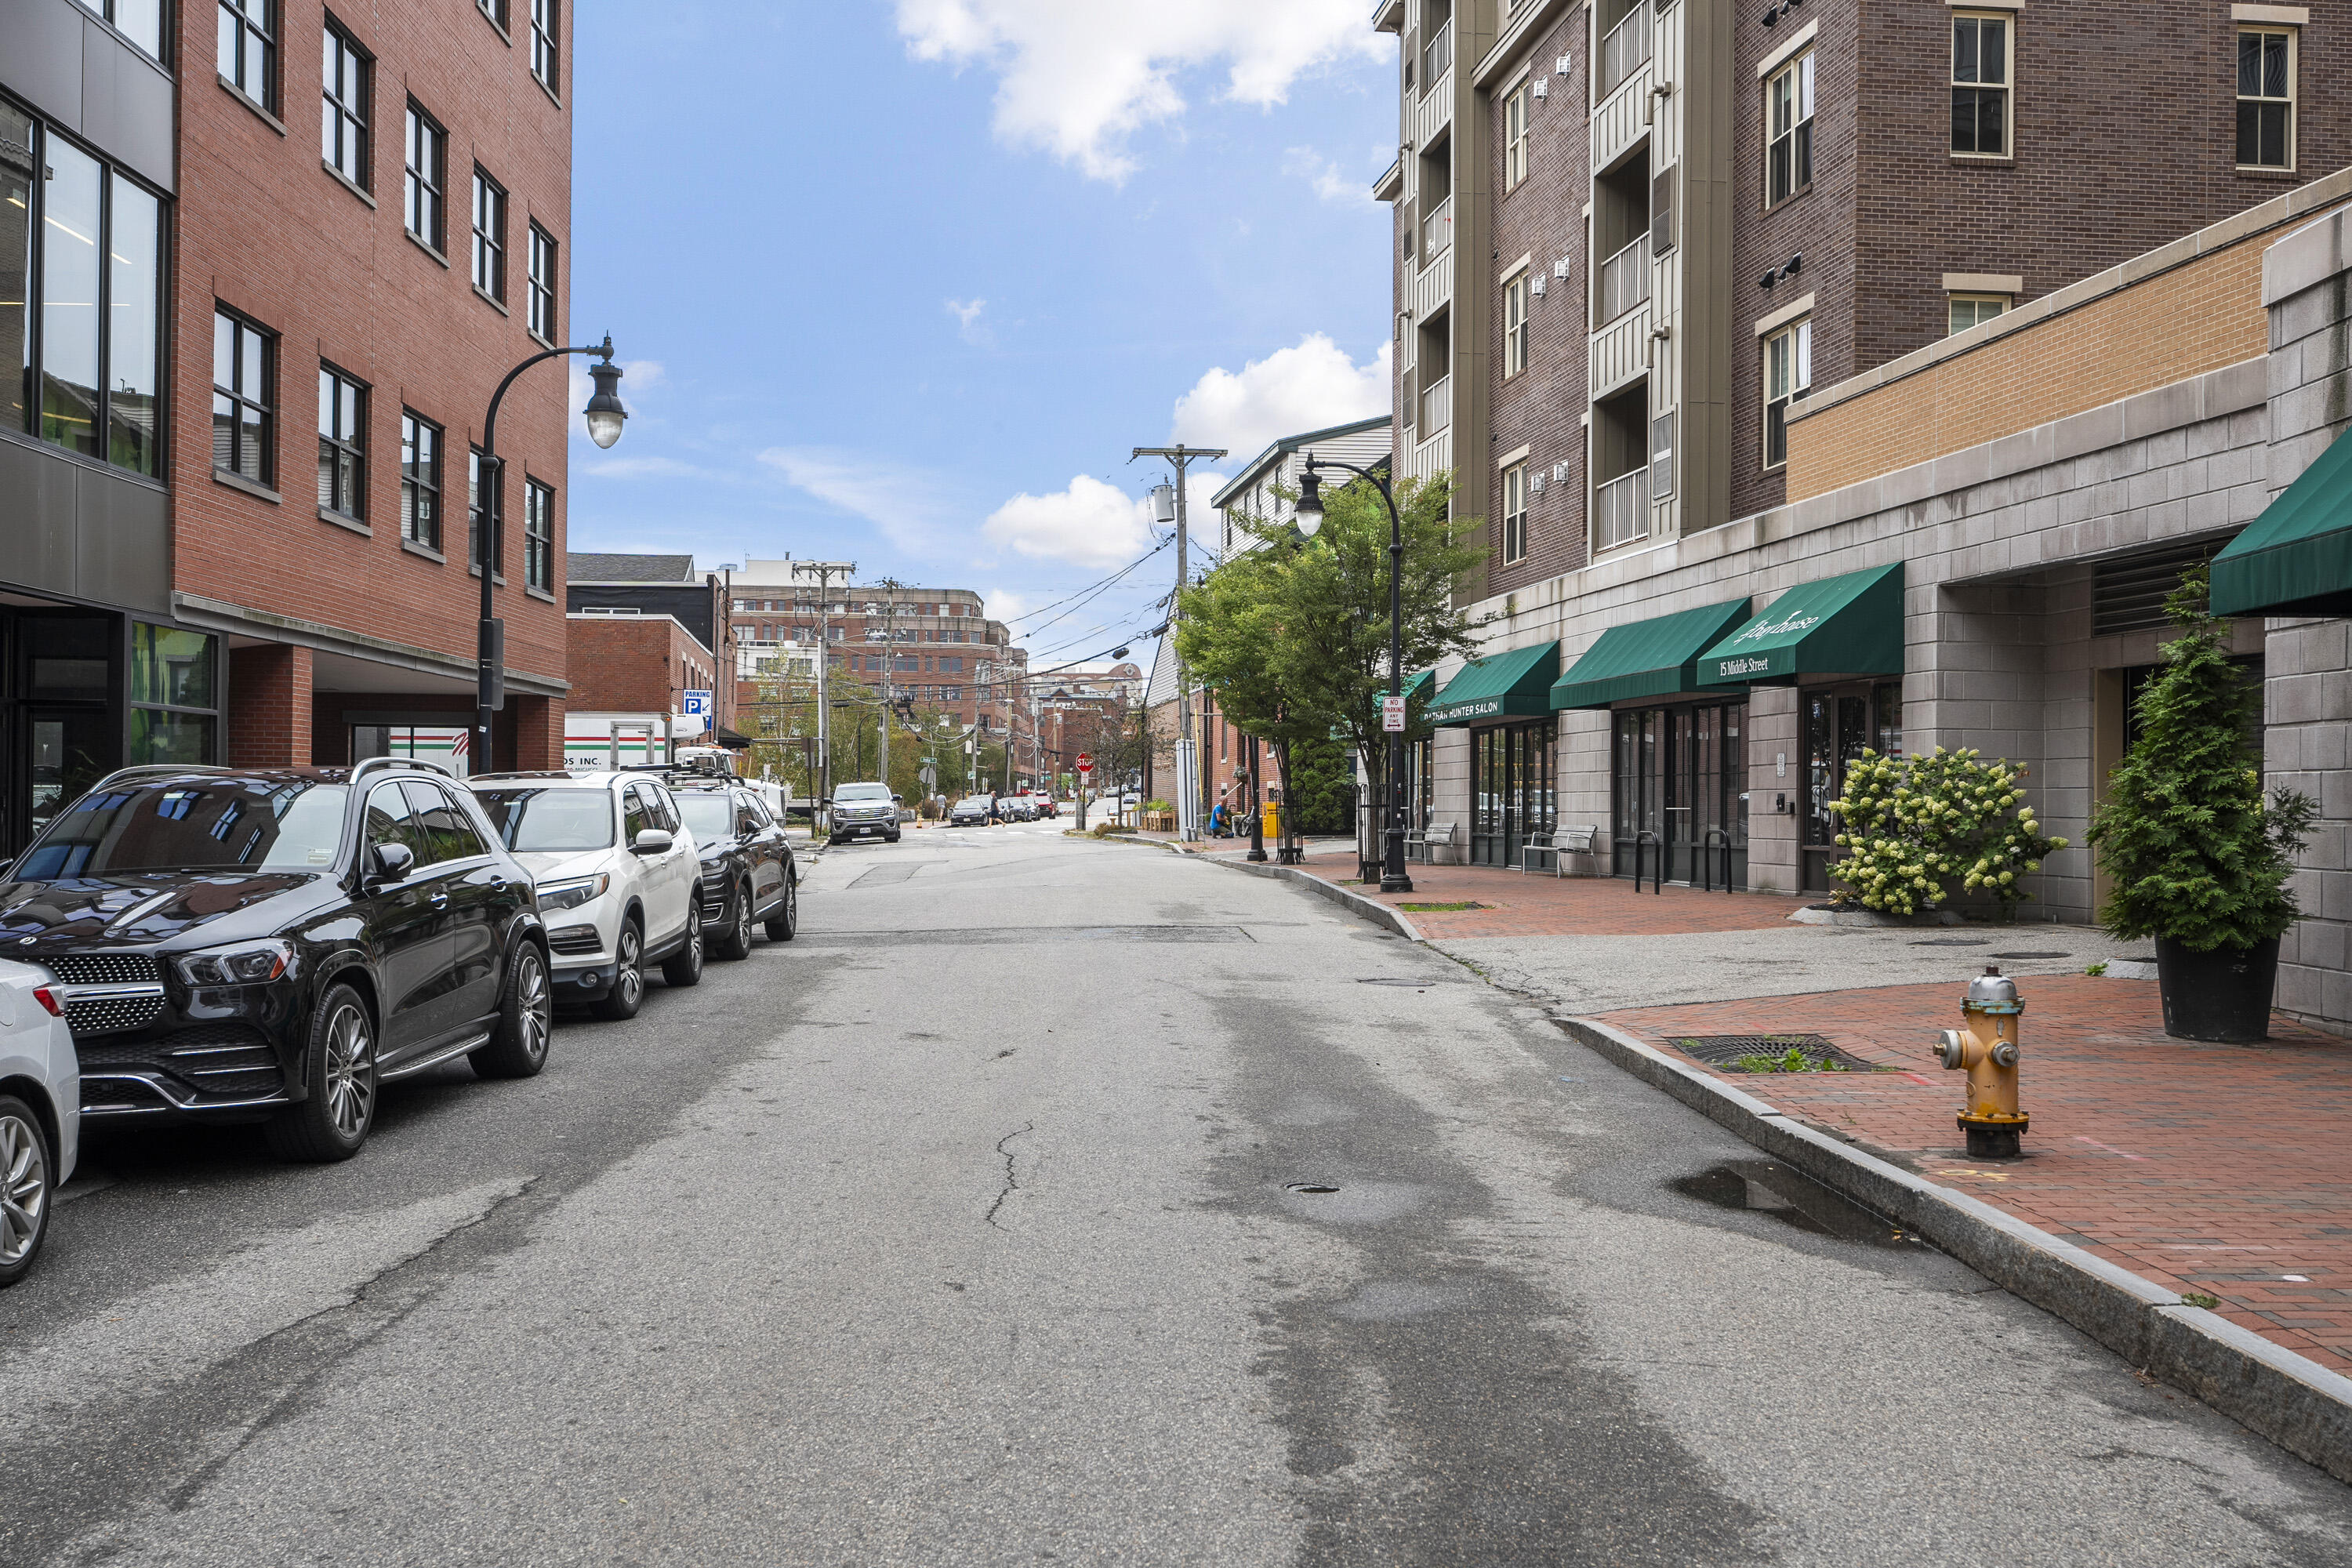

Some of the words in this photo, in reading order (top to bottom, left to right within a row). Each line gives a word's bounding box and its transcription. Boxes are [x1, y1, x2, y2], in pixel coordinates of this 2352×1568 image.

[1769, 610, 1819, 634] house
[1720, 662, 1727, 677] 15
[1727, 659, 1748, 675] Middle
[1748, 657, 1769, 673] Street
[688, 700, 699, 713] P
[1450, 706, 1474, 718] HUNTER
[1475, 701, 1498, 715] SALON
[1077, 758, 1094, 767] STOP
